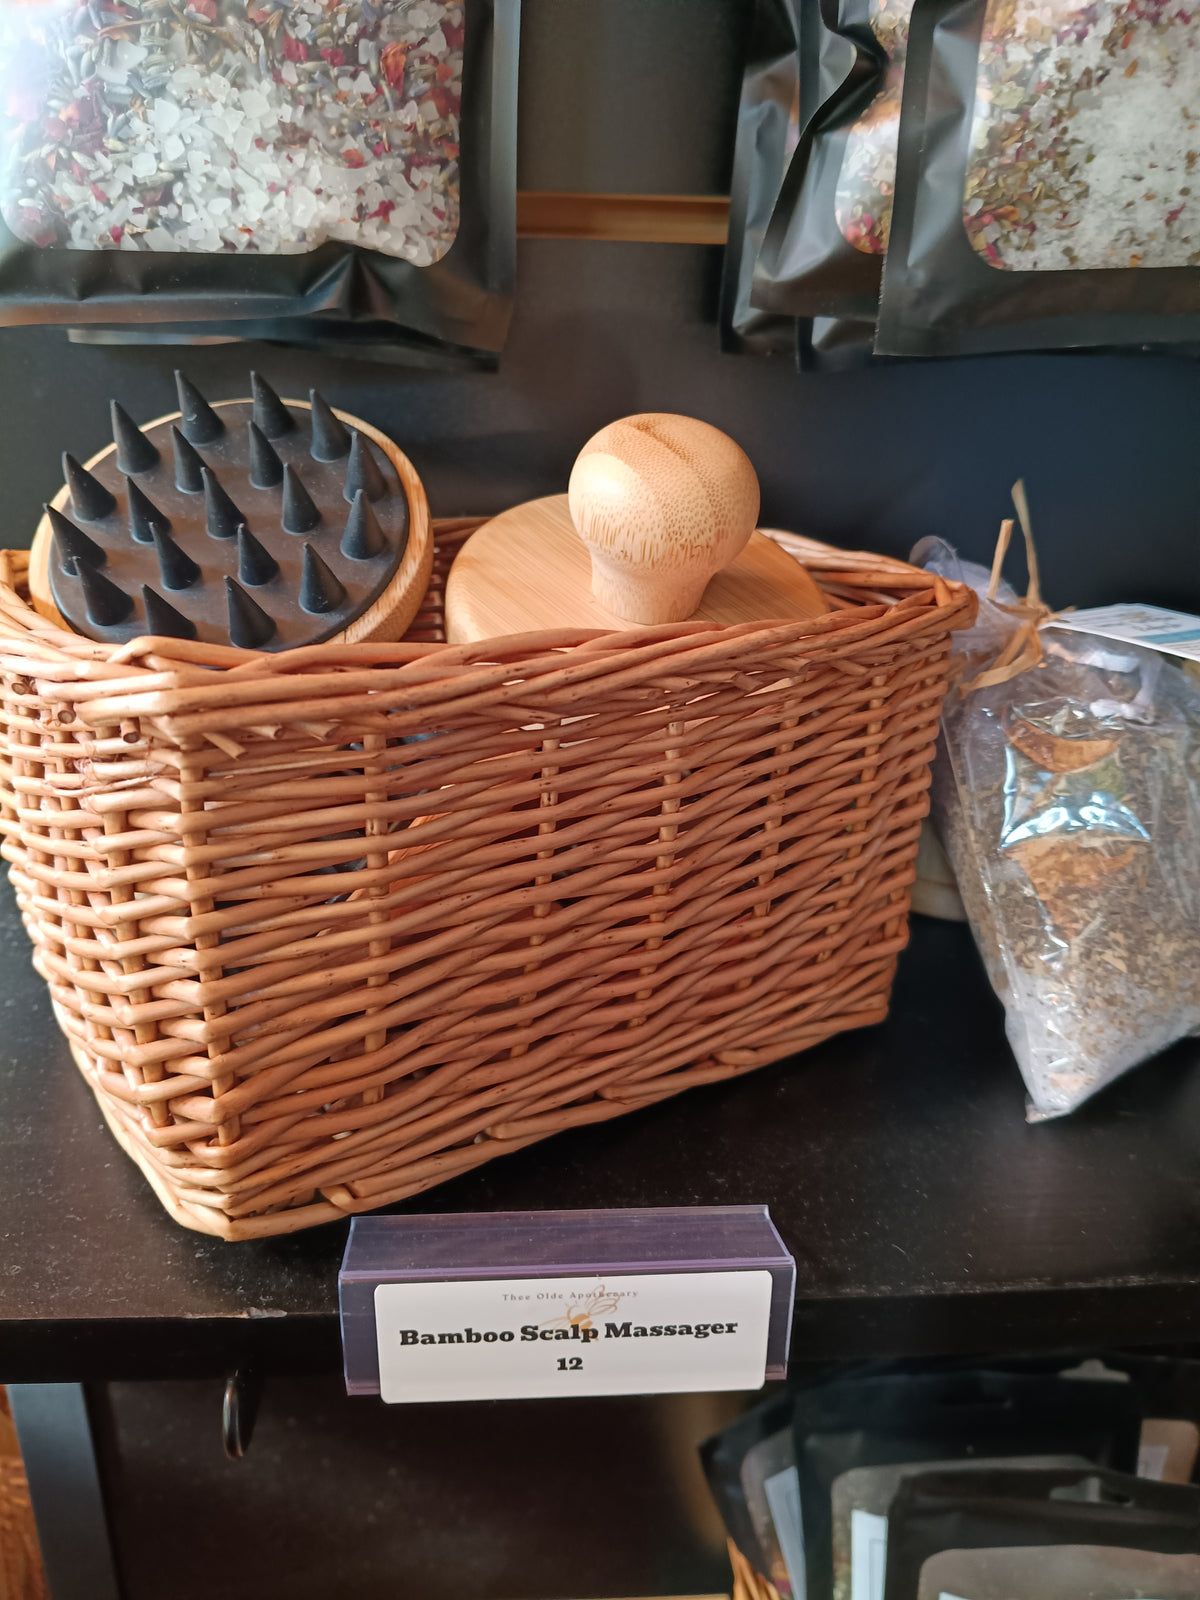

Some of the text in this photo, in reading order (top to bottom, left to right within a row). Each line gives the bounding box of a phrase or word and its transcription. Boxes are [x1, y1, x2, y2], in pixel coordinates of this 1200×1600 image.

[502, 1293, 531, 1302] Thee
[536, 1292, 564, 1300] Olde
[399, 1322, 738, 1346] Bamboo Scalp Massager
[556, 1357, 584, 1371] 12
